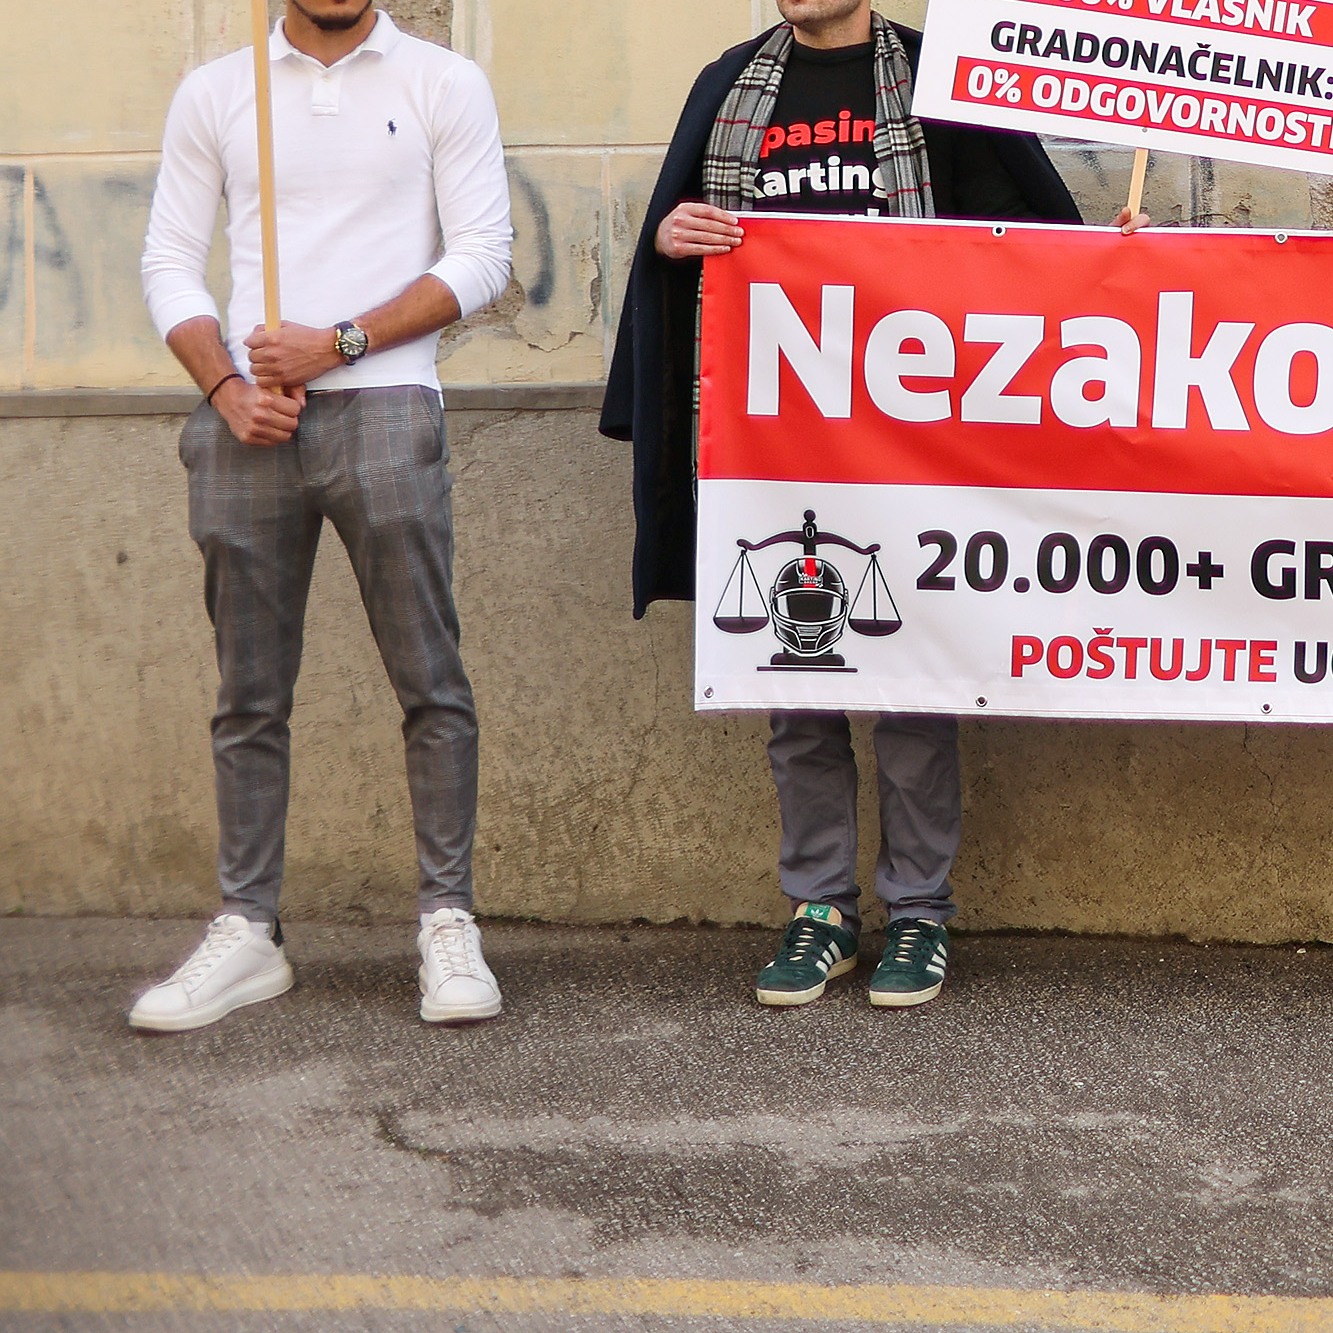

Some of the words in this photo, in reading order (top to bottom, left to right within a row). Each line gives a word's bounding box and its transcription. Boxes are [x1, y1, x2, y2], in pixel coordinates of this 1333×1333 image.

[967, 66, 1022, 103] 0%
[916, 528, 1225, 597] 20.000+
[1011, 627, 1278, 685] POŠTUJTE
